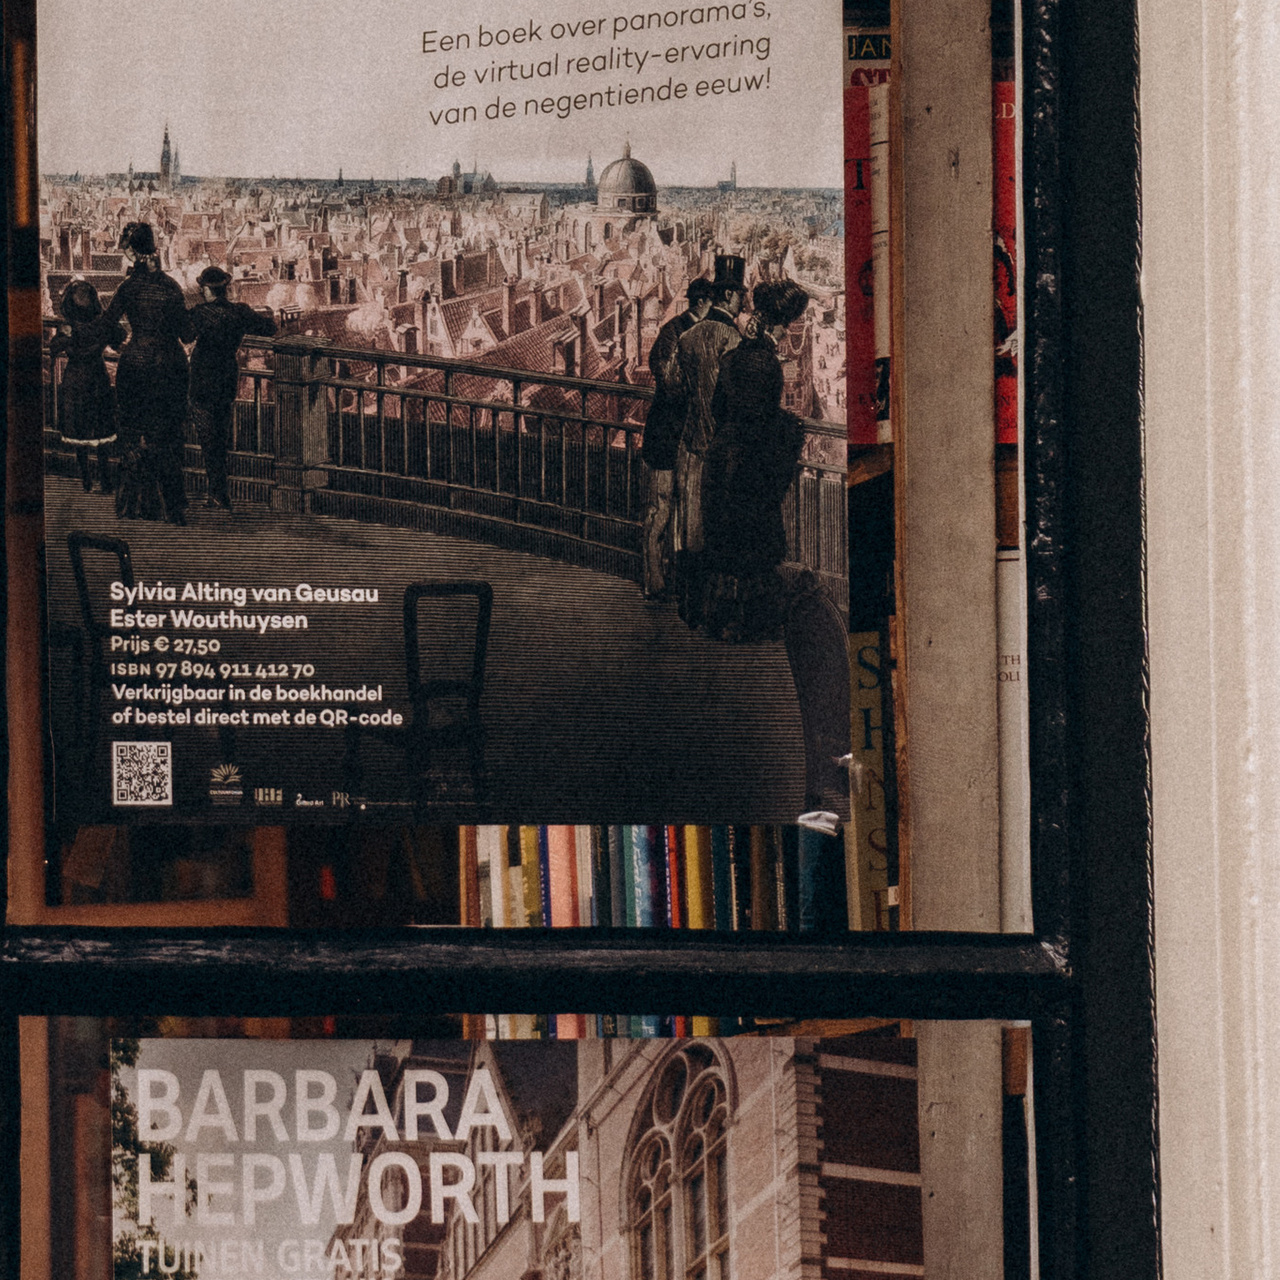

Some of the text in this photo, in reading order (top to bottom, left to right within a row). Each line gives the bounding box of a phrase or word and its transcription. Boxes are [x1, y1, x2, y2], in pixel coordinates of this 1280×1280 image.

[422, 28, 470, 54] Een
[477, 19, 543, 50] boek
[548, 16, 608, 42] over
[432, 33, 772, 89] de virtual reality-ervaring
[428, 67, 773, 128] van de negentiende eeuw!
[110, 581, 379, 607] Sylvia Alting van Geusau
[110, 608, 308, 634] Ester Wouthuysen
[110, 636, 221, 656] Prijs € 27,50
[111, 661, 315, 679] ISBN 97 894 911 412 70
[112, 684, 383, 705] Verkrijgbaar in de boekhandel
[112, 707, 404, 727] of bestel direct met de QR-code
[136, 1068, 513, 1142] BARBARA
[136, 1150, 581, 1226] HEPWORTH
[277, 1237, 403, 1274] GRATIS
